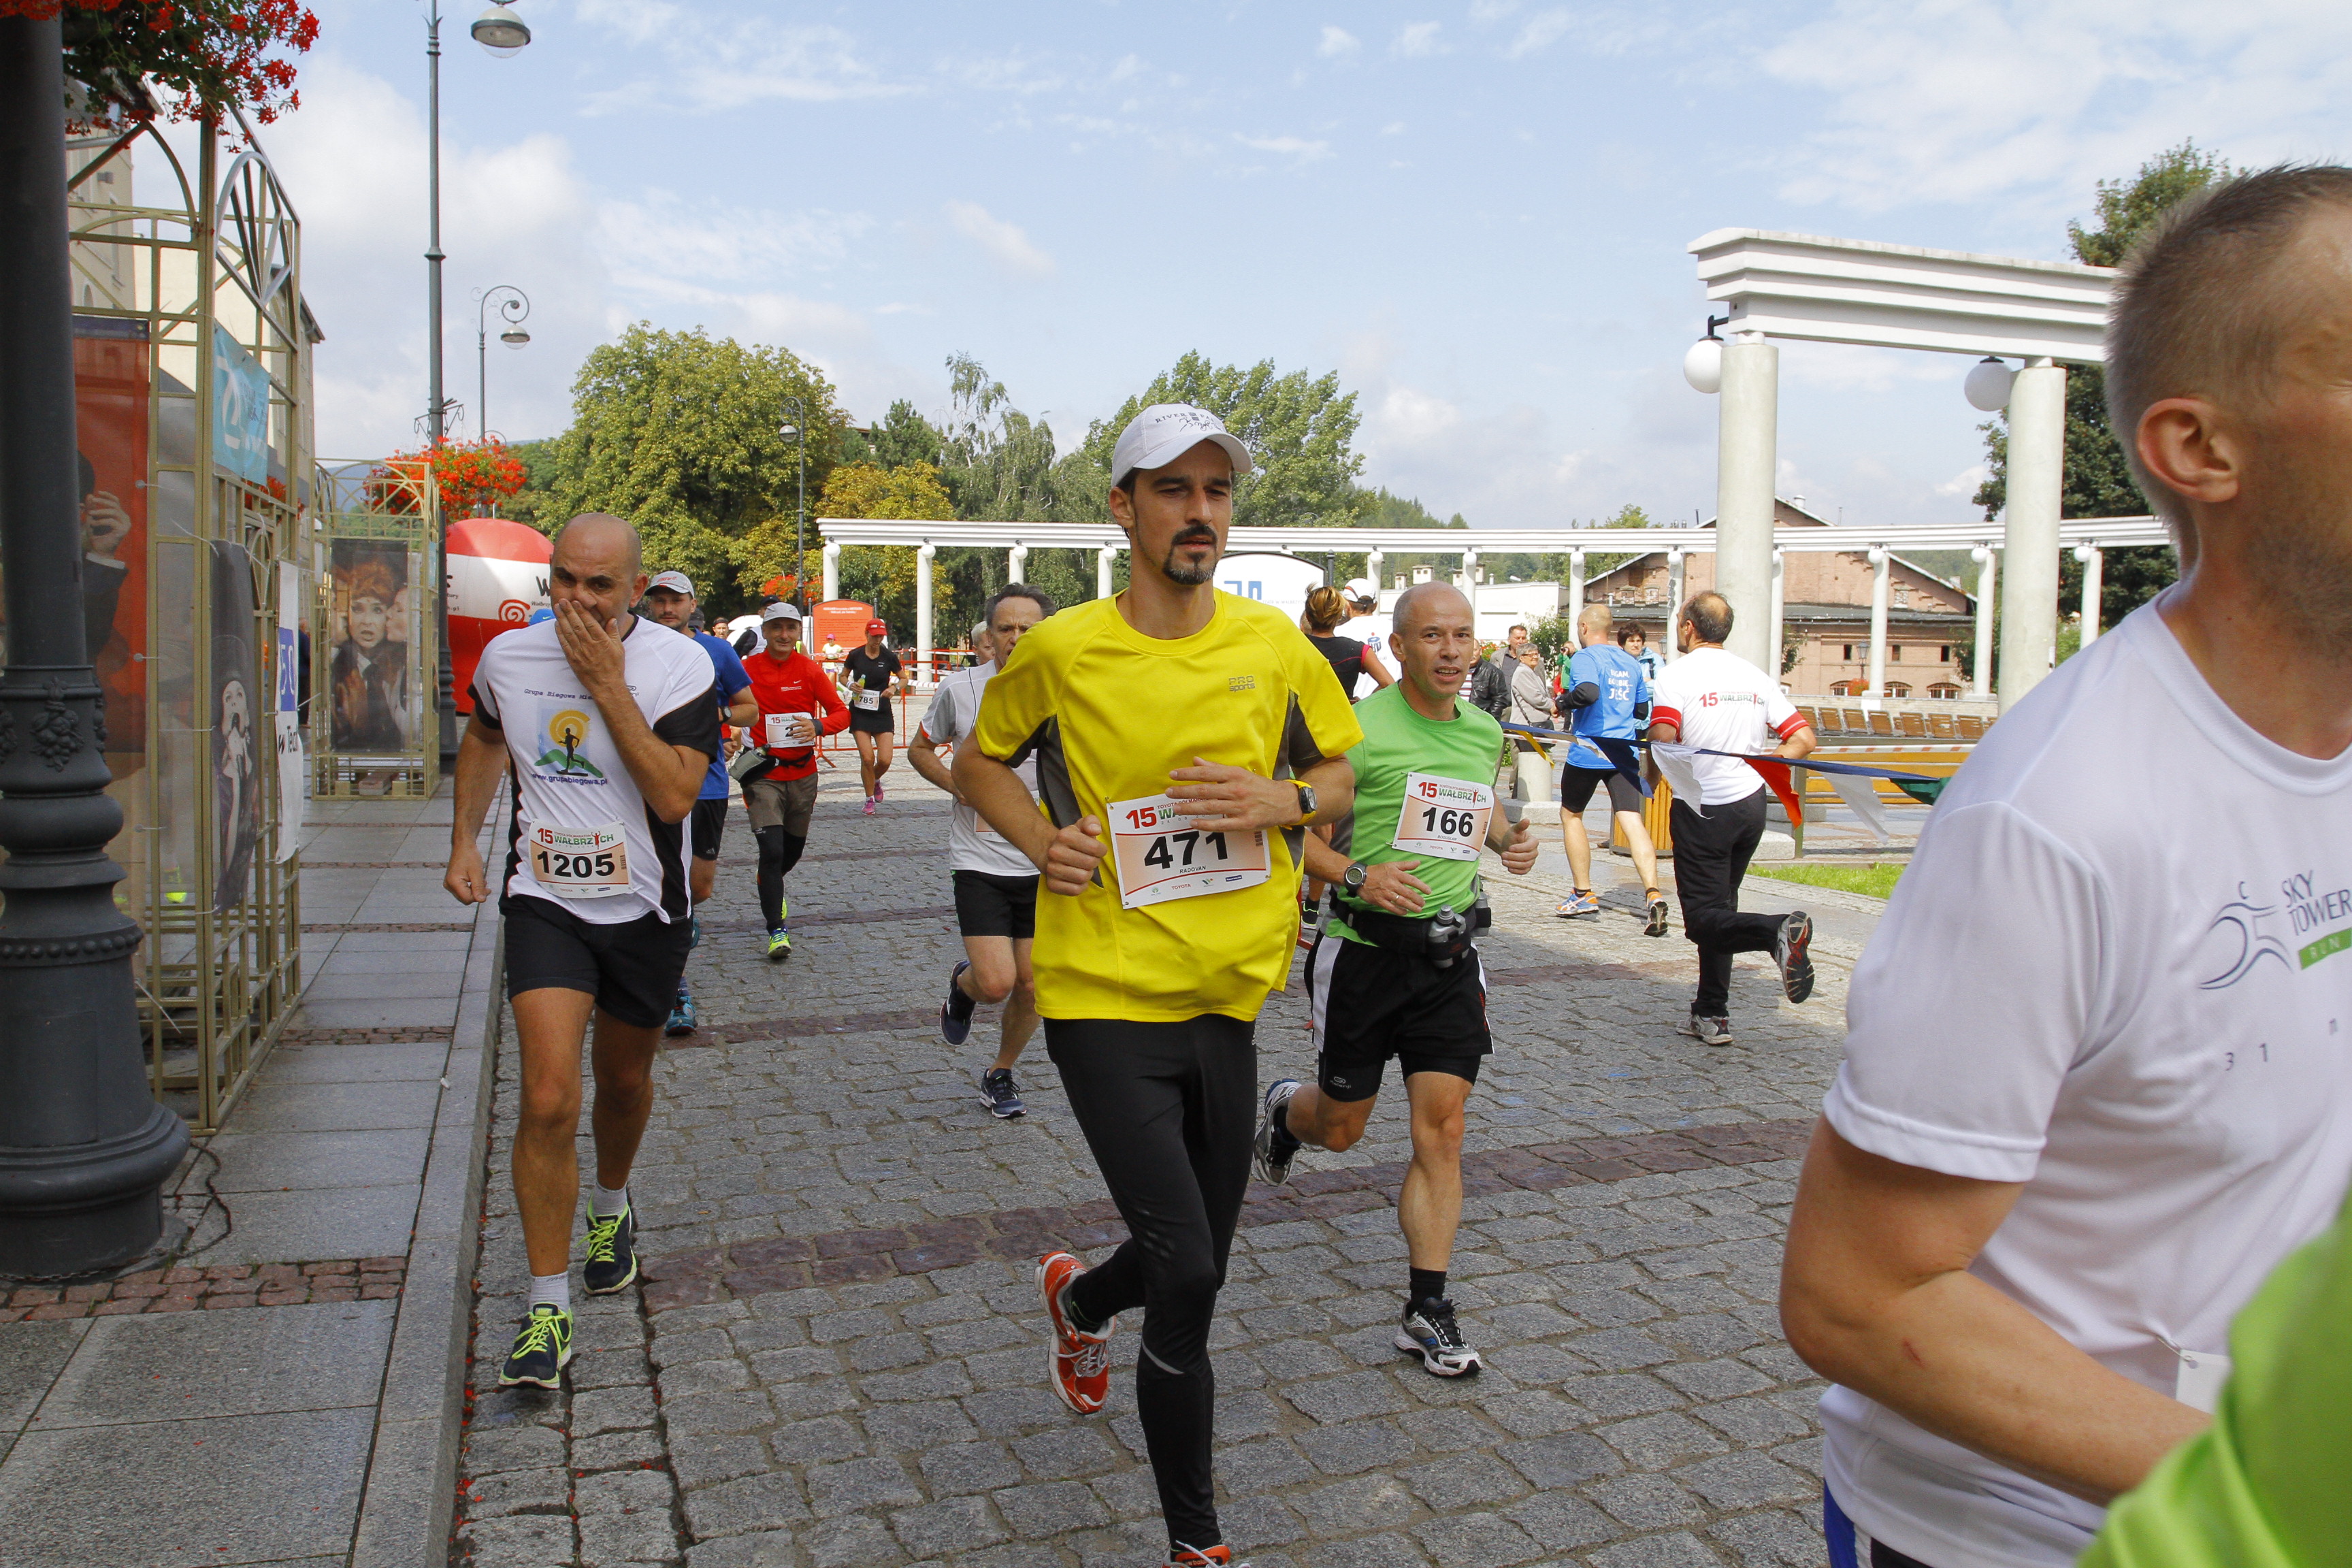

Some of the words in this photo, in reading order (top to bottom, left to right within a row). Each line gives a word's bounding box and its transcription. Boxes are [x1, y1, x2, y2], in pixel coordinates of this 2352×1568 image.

[1156, 412, 1187, 423] RIVER
[1228, 675, 1254, 685] PRO
[1229, 683, 1255, 693] sports
[859, 696, 874, 704] 785
[1699, 692, 1718, 707] 15
[531, 772, 608, 786] www.grupabiegowa.pl
[1418, 781, 1438, 798] 15
[1125, 806, 1157, 830] 15
[1422, 806, 1474, 838] 166
[537, 828, 553, 845] 15
[1144, 830, 1228, 870] 471
[537, 851, 615, 879] 1205
[1179, 865, 1207, 874] RADOVAN
[2282, 870, 2313, 908] SKY
[2289, 889, 2352, 936] TOWER
